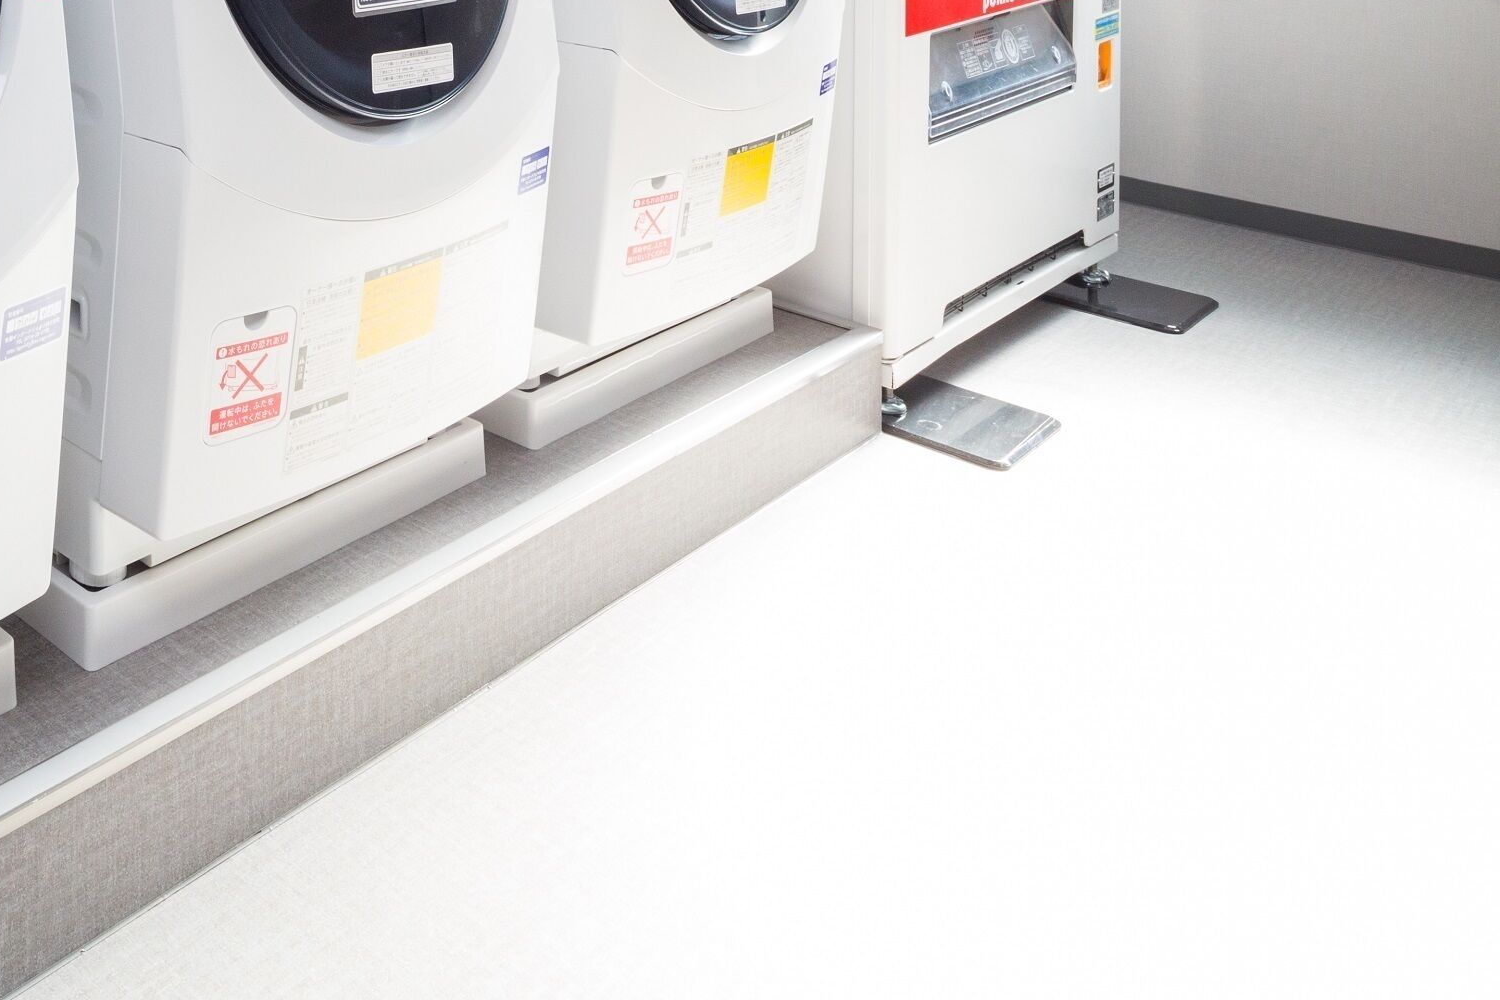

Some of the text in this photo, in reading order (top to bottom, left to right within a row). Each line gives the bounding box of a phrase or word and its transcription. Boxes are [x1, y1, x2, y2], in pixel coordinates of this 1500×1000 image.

[227, 335, 287, 357] 水もれの恐れあり
